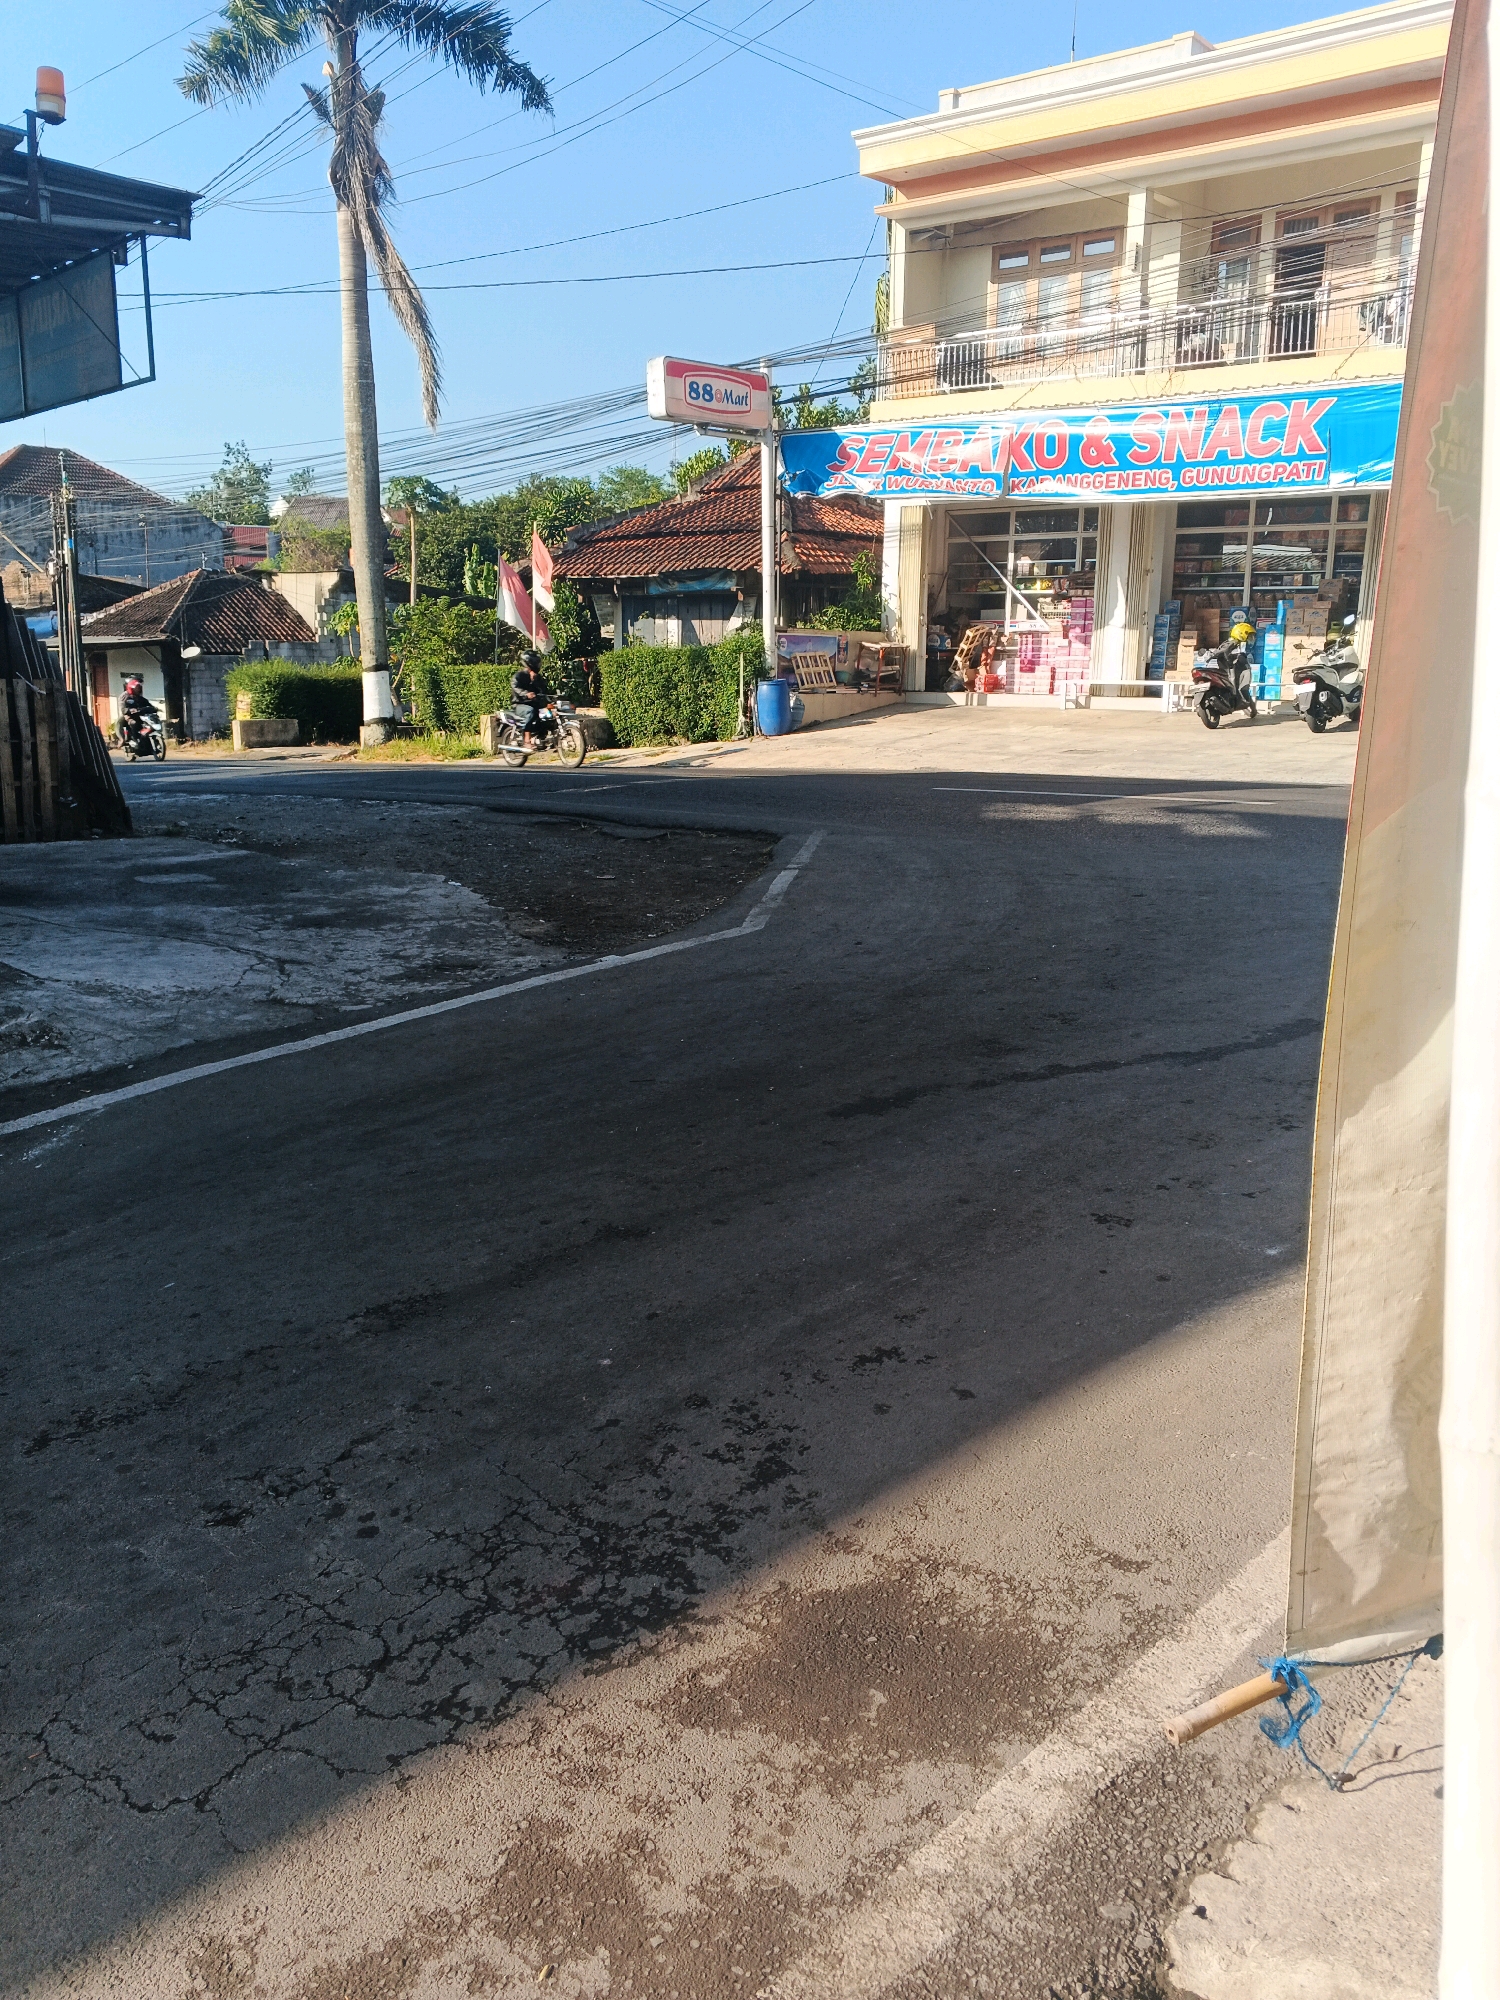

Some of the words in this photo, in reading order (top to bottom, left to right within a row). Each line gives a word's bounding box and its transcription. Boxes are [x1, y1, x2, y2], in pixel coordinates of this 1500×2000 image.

[688, 381, 714, 403] 88
[826, 420, 1069, 474] SEMBAKO
[1080, 415, 1119, 468] &
[1127, 397, 1337, 465] SNACK
[1180, 460, 1328, 487] GUNUNGPATI
